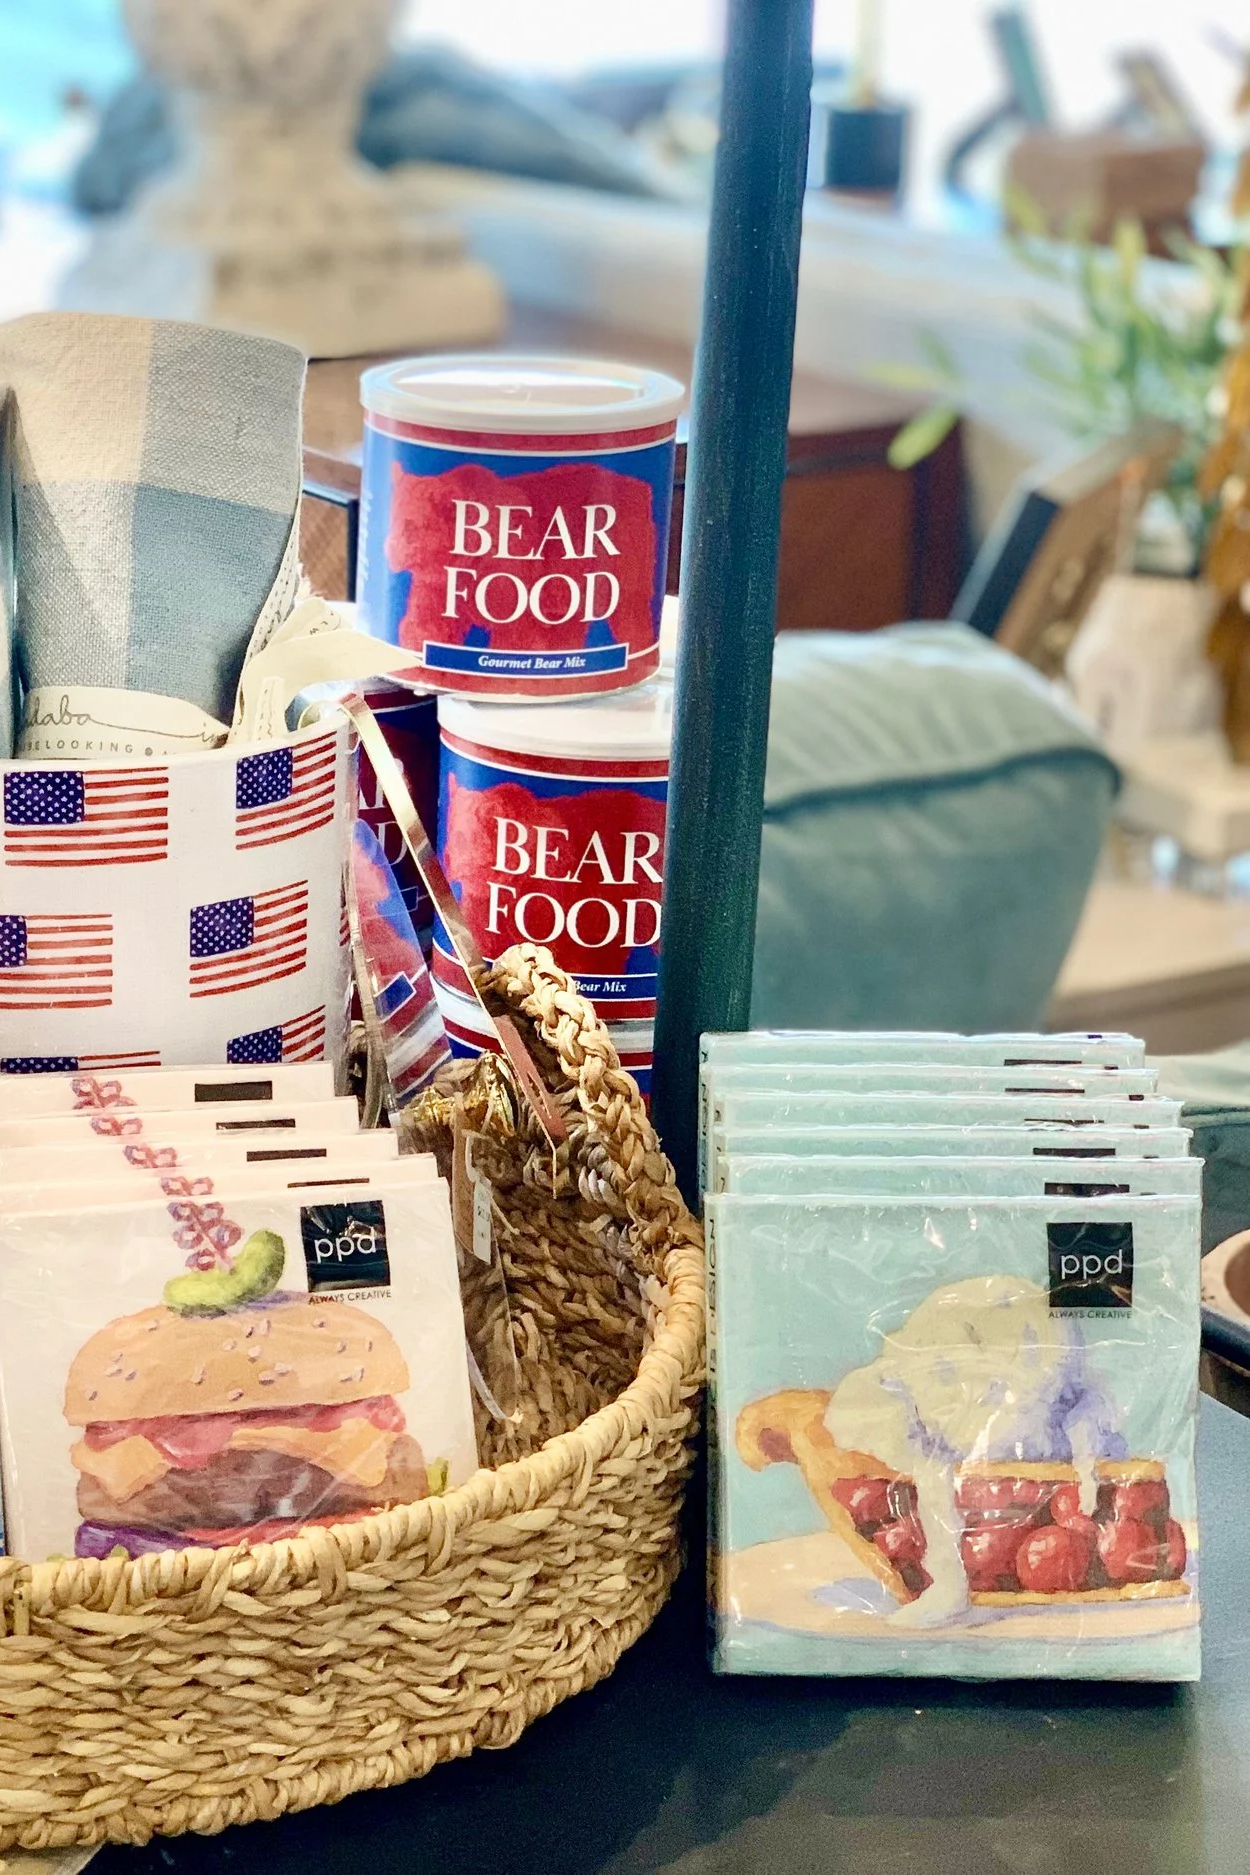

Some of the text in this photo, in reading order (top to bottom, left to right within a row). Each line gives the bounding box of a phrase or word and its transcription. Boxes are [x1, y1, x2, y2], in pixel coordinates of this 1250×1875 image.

[449, 499, 621, 560] BEAR
[440, 566, 621, 625] FOOD
[478, 655, 586, 669] Gourmet Bear Mix
[491, 816, 664, 885] BEAR
[485, 882, 661, 949] FOOD
[603, 980, 627, 993] Mix
[314, 1229, 377, 1263] ppd
[1060, 1249, 1123, 1280] ppd
[308, 1290, 392, 1306] ALWAYS CREATIVE
[1049, 1310, 1132, 1319] ALWAYS CREATIVE
